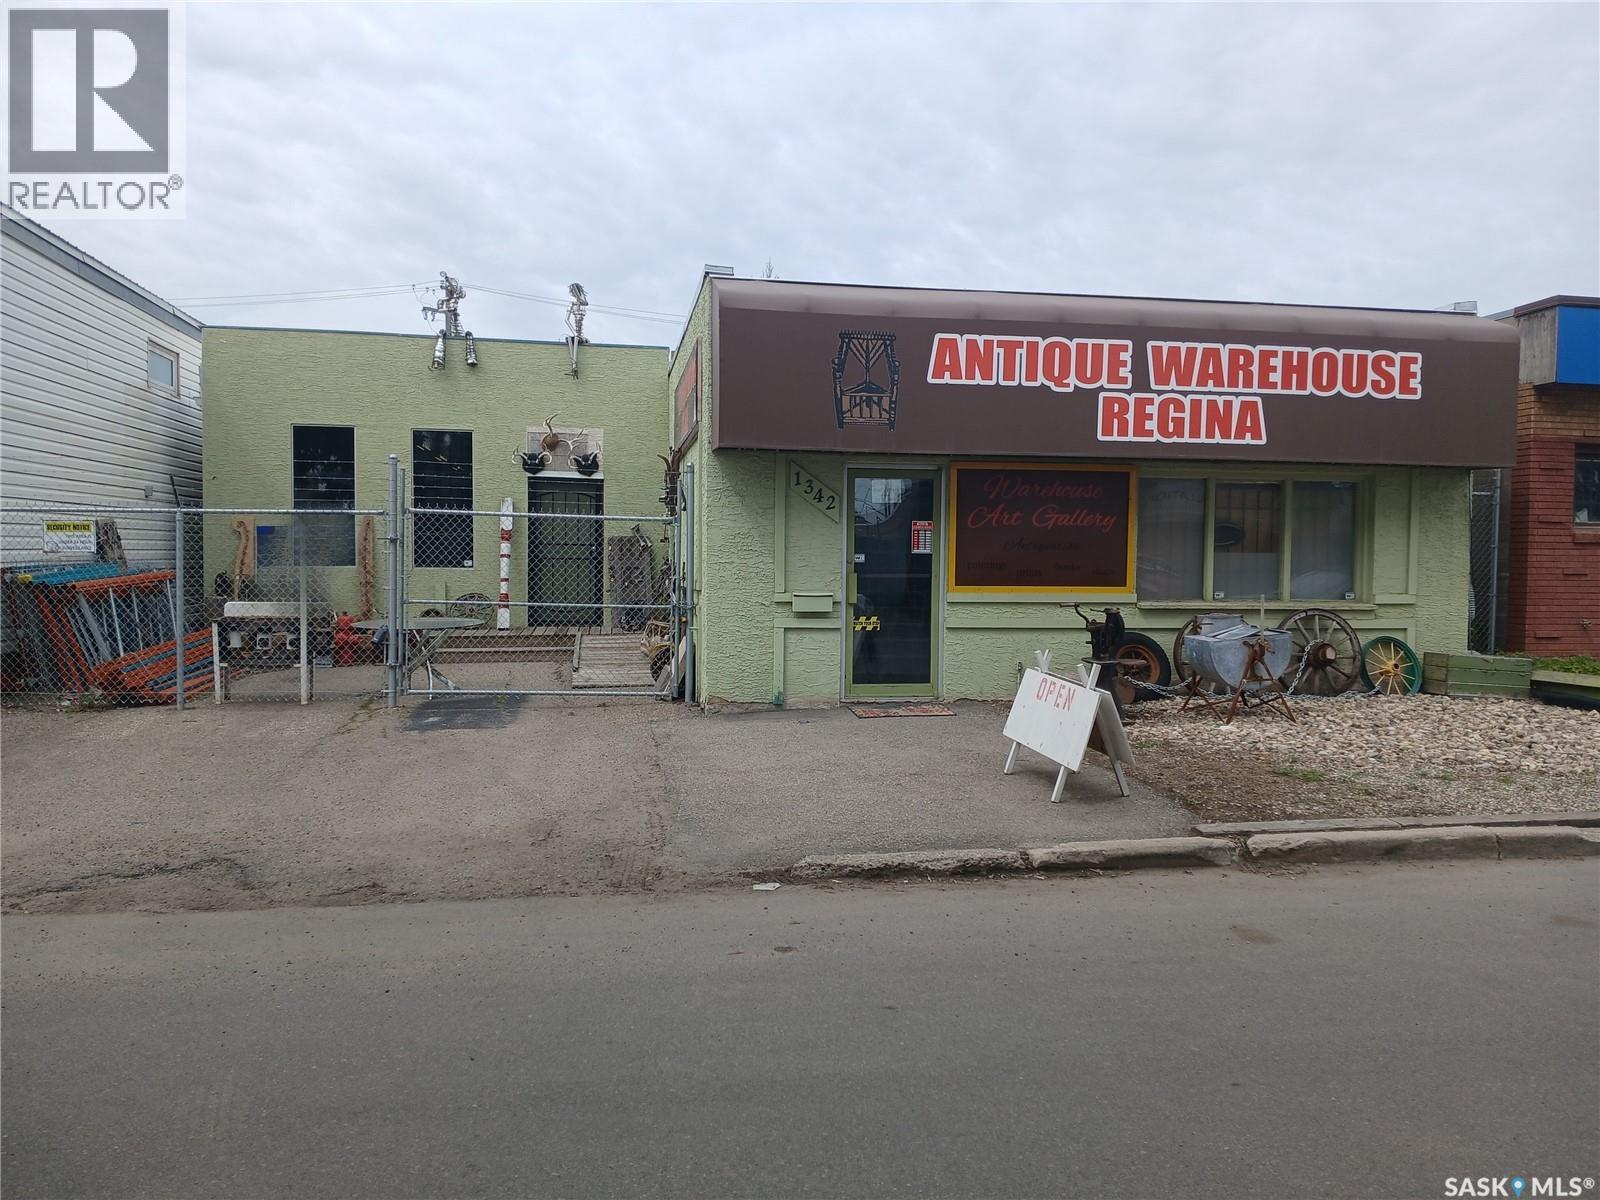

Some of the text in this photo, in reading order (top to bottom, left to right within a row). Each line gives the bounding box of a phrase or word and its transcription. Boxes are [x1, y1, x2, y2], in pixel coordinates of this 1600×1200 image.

[928, 334, 1422, 399] ANTIQUE WAREHOUSE
[1098, 392, 1267, 444] REGINA
[794, 471, 836, 510] 1342
[983, 475, 1103, 499] Warehouse
[967, 503, 1117, 532] Art Gallery
[1036, 677, 1076, 712] OPEN
